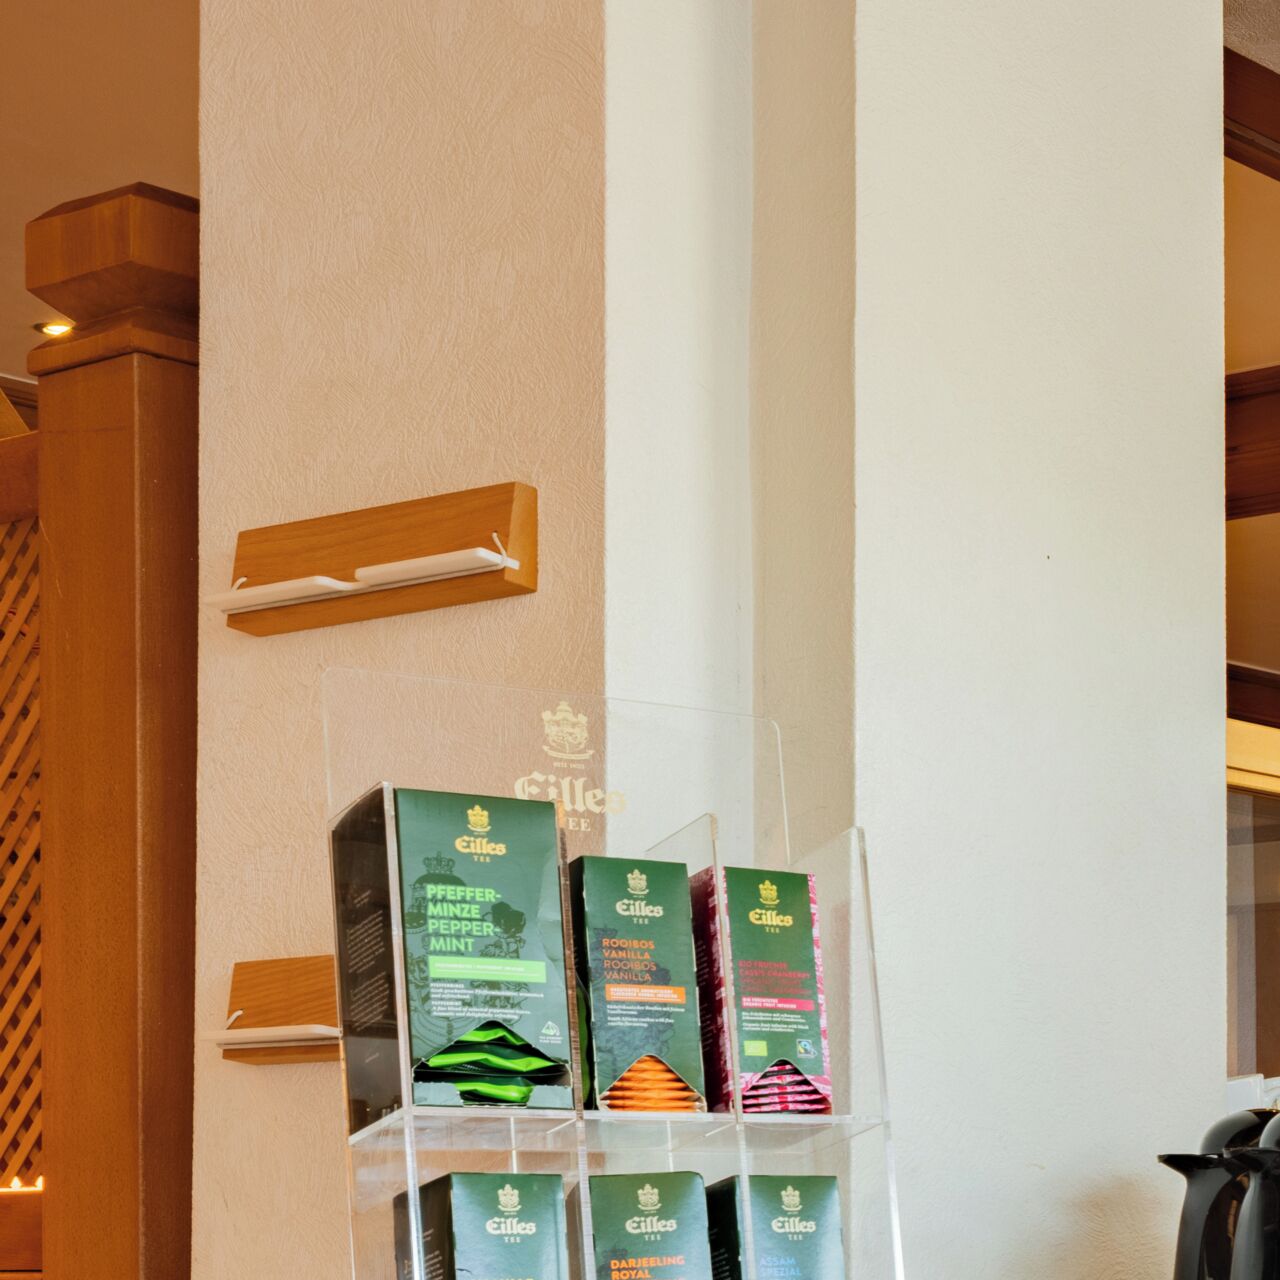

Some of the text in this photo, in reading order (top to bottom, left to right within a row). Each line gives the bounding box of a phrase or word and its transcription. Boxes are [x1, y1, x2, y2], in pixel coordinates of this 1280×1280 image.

[567, 817, 591, 832] EE
[454, 835, 508, 856] Eilles
[473, 855, 491, 863] TEE
[426, 884, 502, 902] PFEFFER-
[427, 901, 481, 919] MINZE
[615, 898, 664, 917] Eilles
[748, 908, 794, 927] Eilles
[428, 919, 503, 937] PEPPER-
[429, 936, 475, 952] MINT
[602, 938, 655, 949] ROOIBOS
[602, 949, 651, 960] VANILLA
[603, 959, 657, 972] ROOIBOS
[604, 970, 652, 981] VANILLA
[485, 1216, 537, 1235] Eilles
[625, 1216, 678, 1234] Eilles
[771, 1216, 817, 1233] Eilles
[610, 1256, 686, 1269] DARJEELING
[611, 1269, 652, 1280] ROYAL
